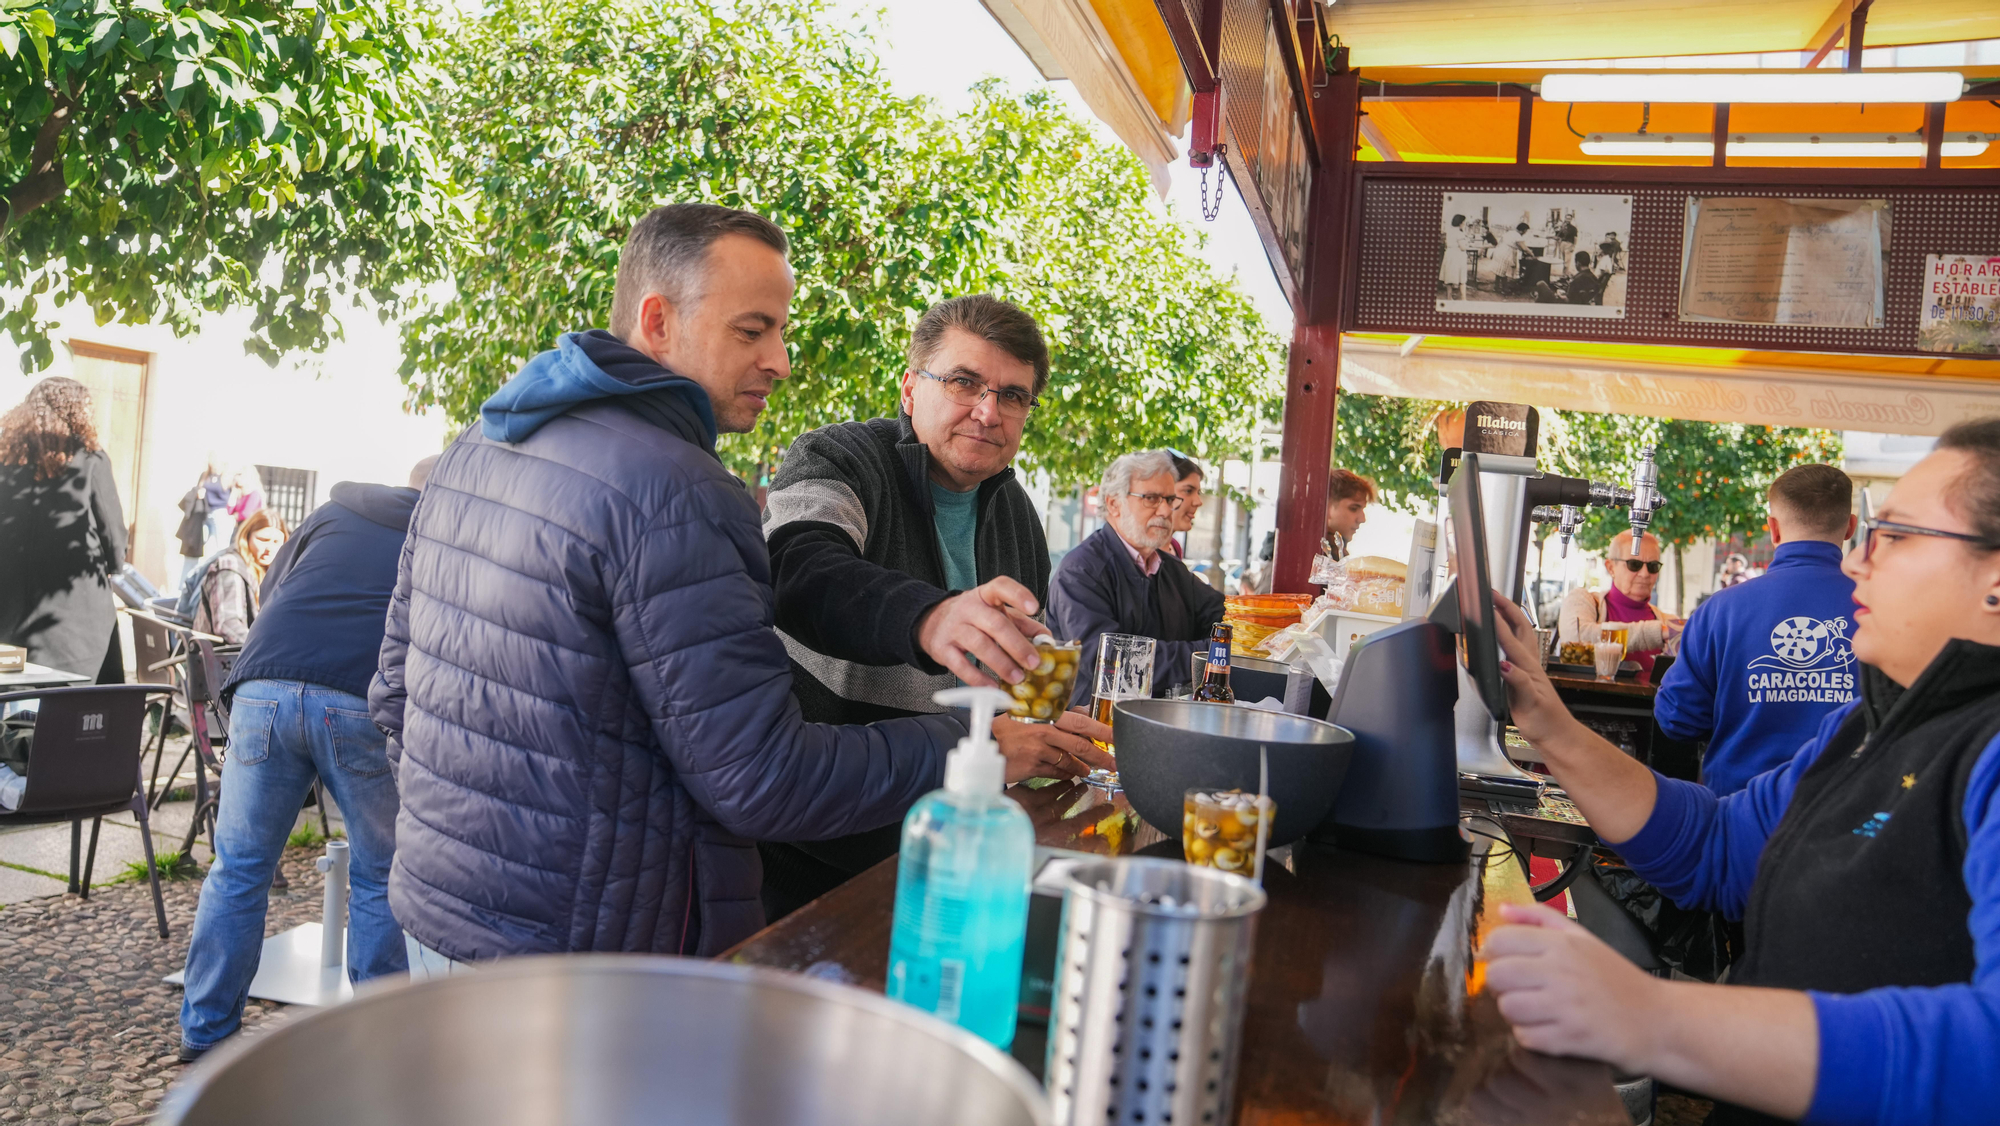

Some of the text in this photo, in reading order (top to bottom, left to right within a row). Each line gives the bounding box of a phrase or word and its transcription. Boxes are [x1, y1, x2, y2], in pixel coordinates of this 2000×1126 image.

[1933, 282, 2000, 295] ESTABLE
[1931, 305, 1994, 321] De 11:30 a
[1477, 415, 1527, 431] Mahou
[1748, 672, 1854, 689] CARACOLES
[1748, 689, 1854, 703] LA MAGDALENA
